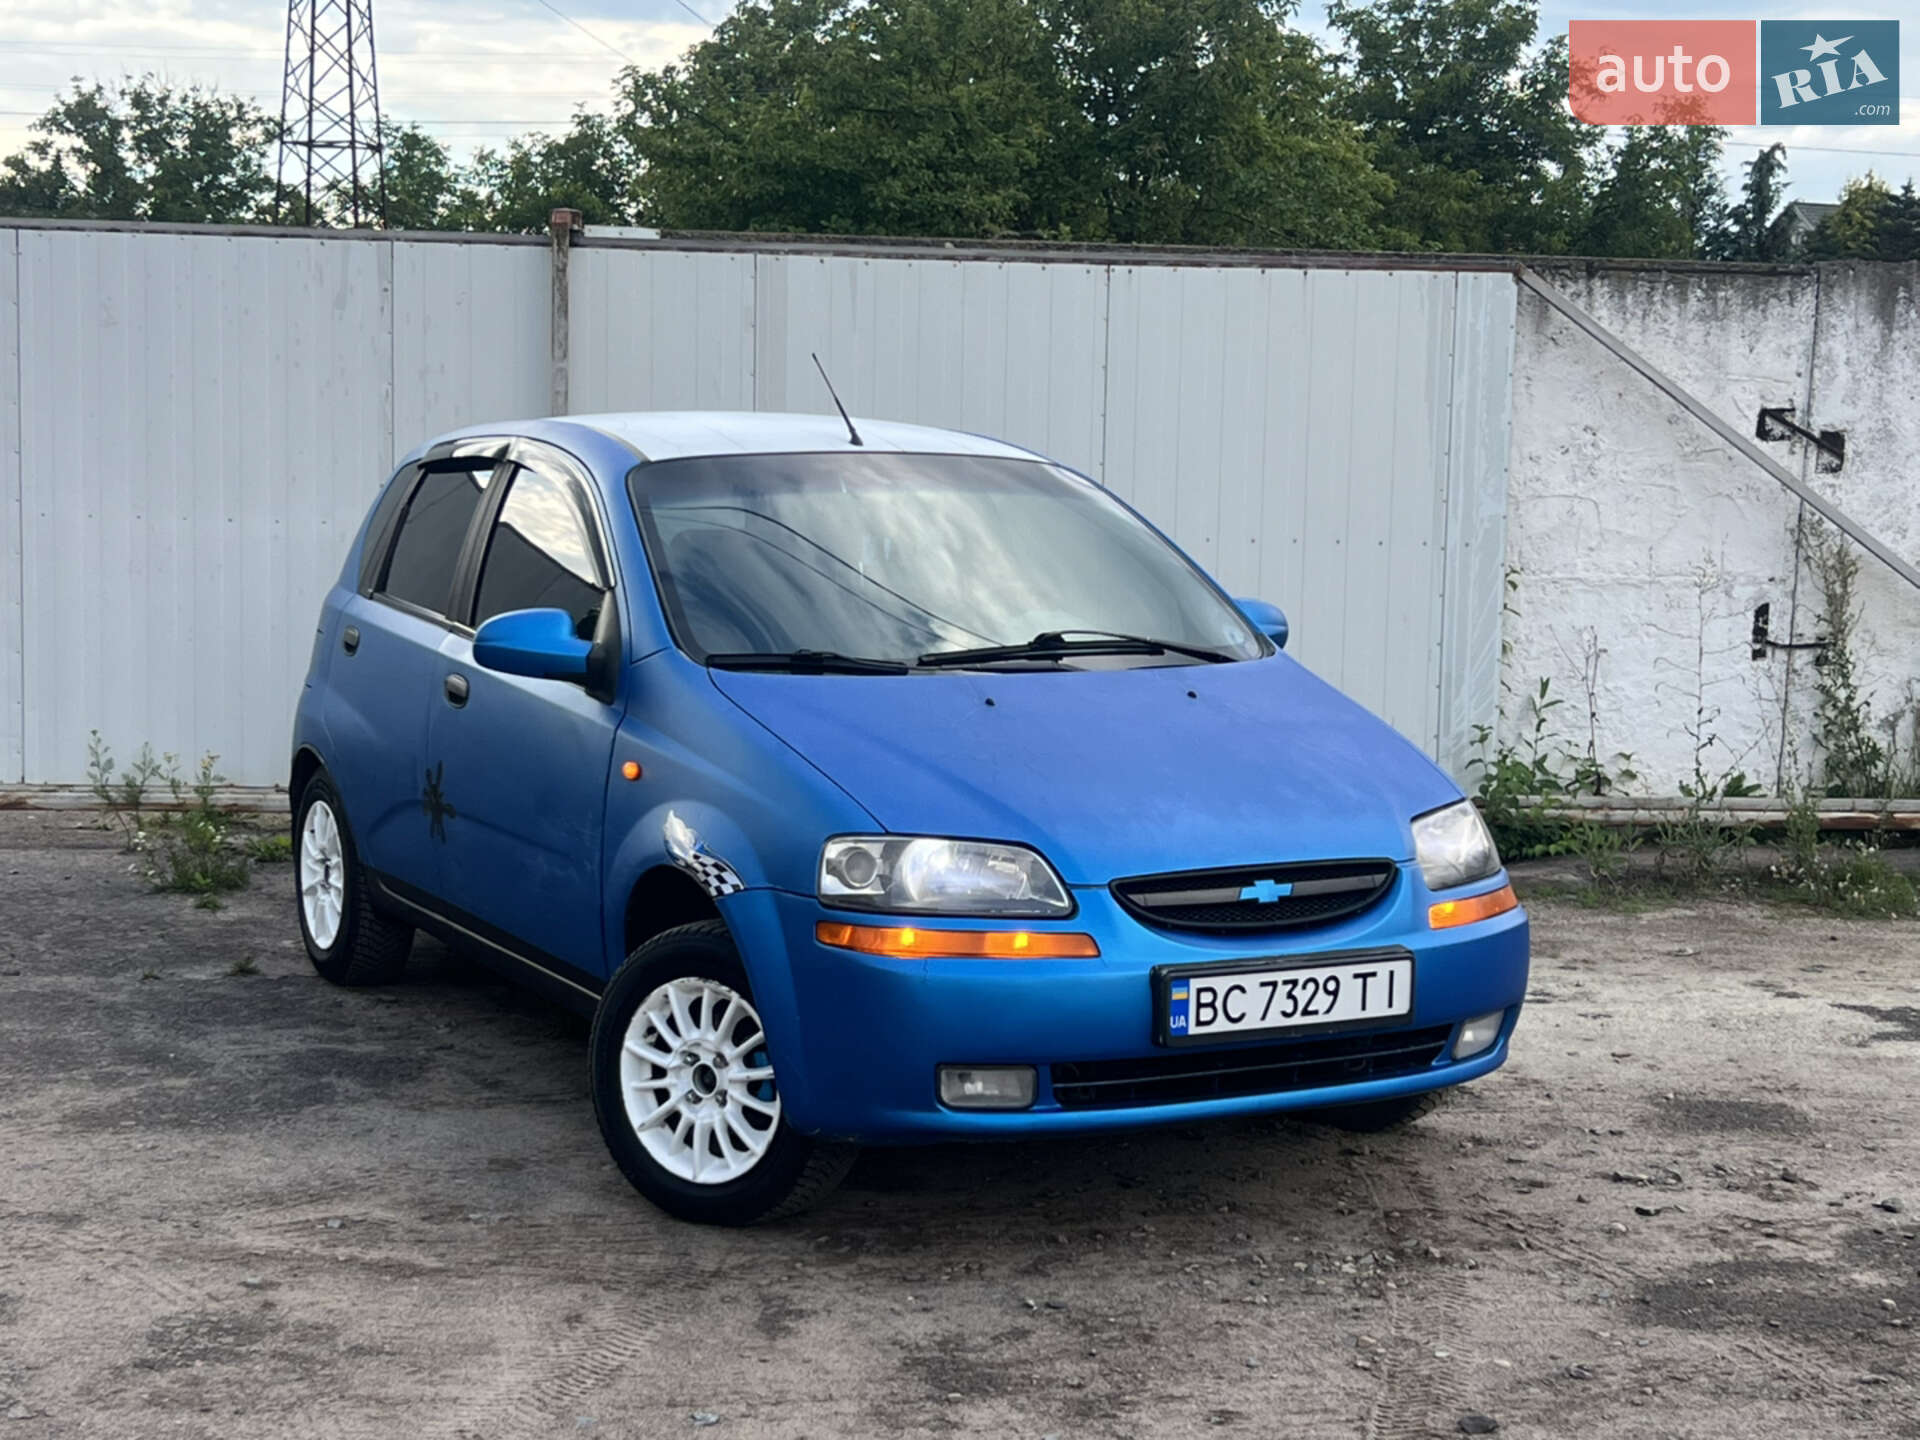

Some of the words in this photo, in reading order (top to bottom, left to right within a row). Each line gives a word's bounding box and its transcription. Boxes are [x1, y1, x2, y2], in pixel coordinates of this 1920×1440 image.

[1195, 984, 1247, 1027] BC
[1259, 975, 1341, 1021] 7329
[1170, 1015, 1187, 1028] UA
